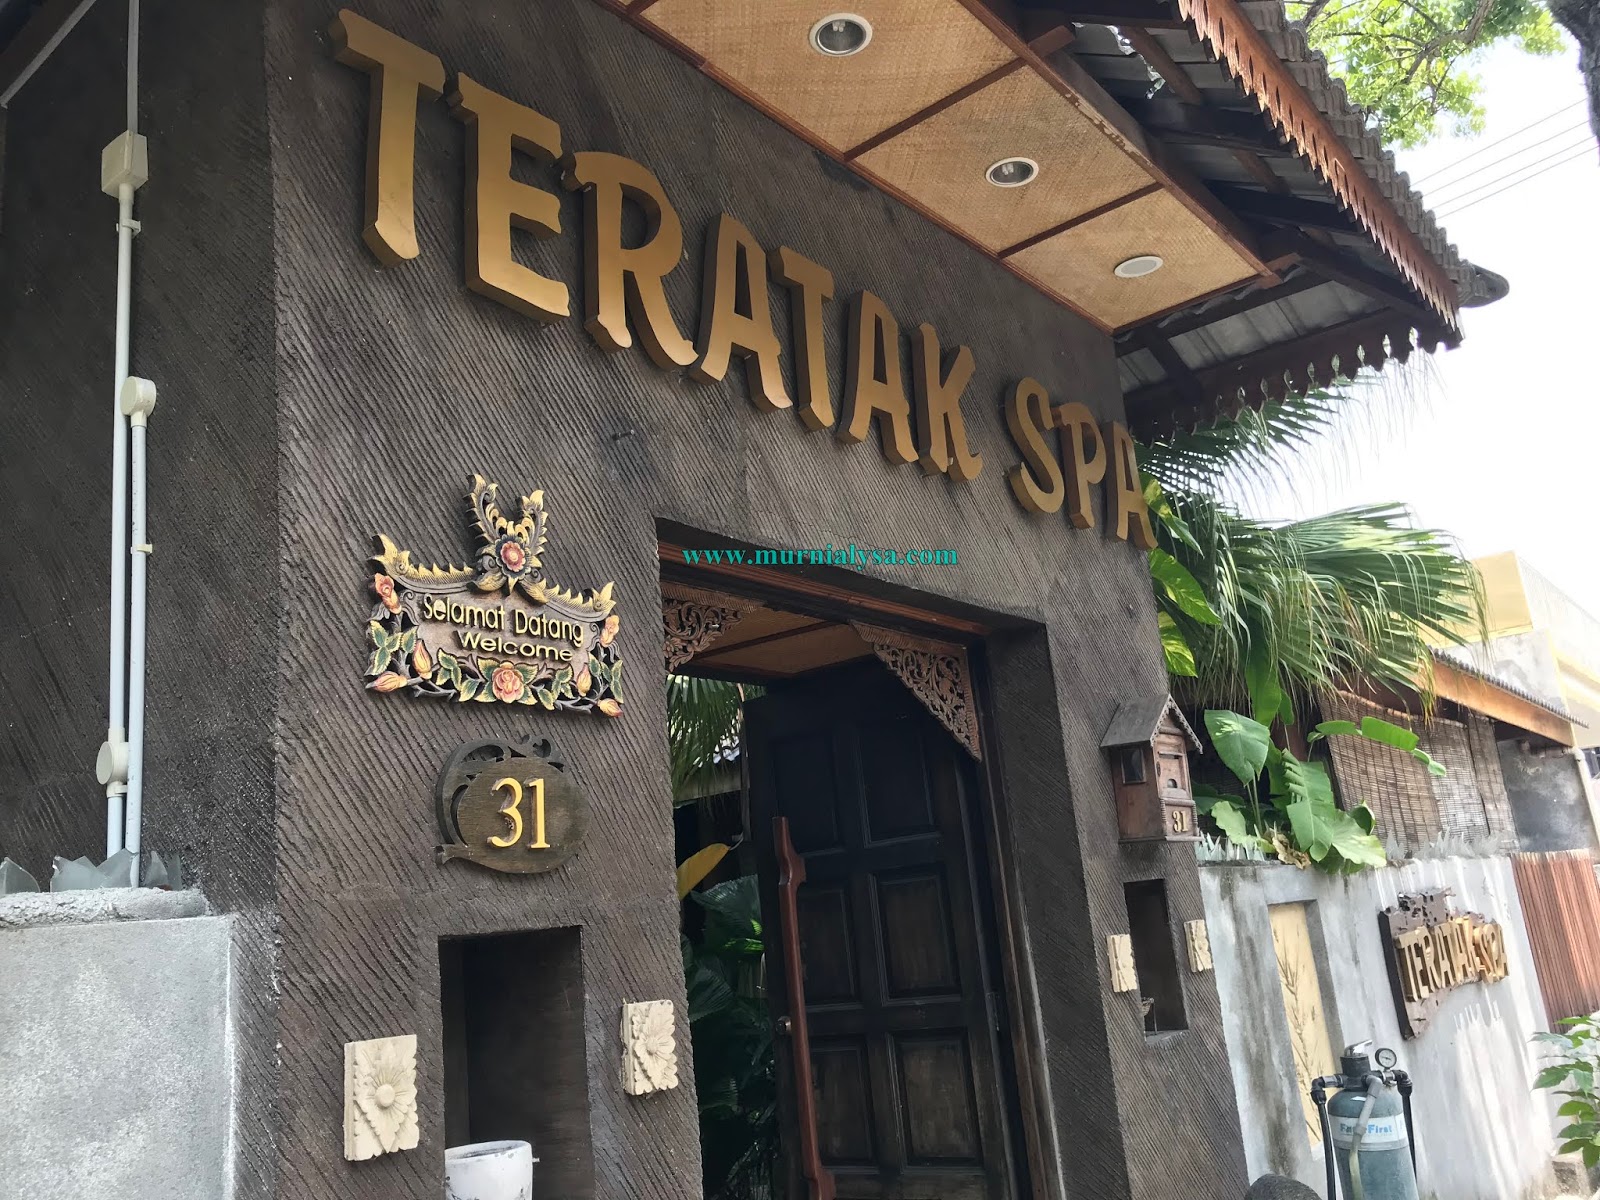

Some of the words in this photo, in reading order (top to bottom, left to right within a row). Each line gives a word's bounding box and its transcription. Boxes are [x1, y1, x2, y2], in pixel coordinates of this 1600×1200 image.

[328, 8, 982, 482] TERATAK
[1005, 376, 1158, 550] SPA
[423, 593, 505, 630] Selamat
[514, 609, 584, 648] Datang
[457, 630, 573, 662] Welcome
[487, 777, 551, 850] 31
[1172, 810, 1189, 833] 31
[1393, 915, 1480, 1002] TERATAK
[1474, 922, 1509, 984] SPA
